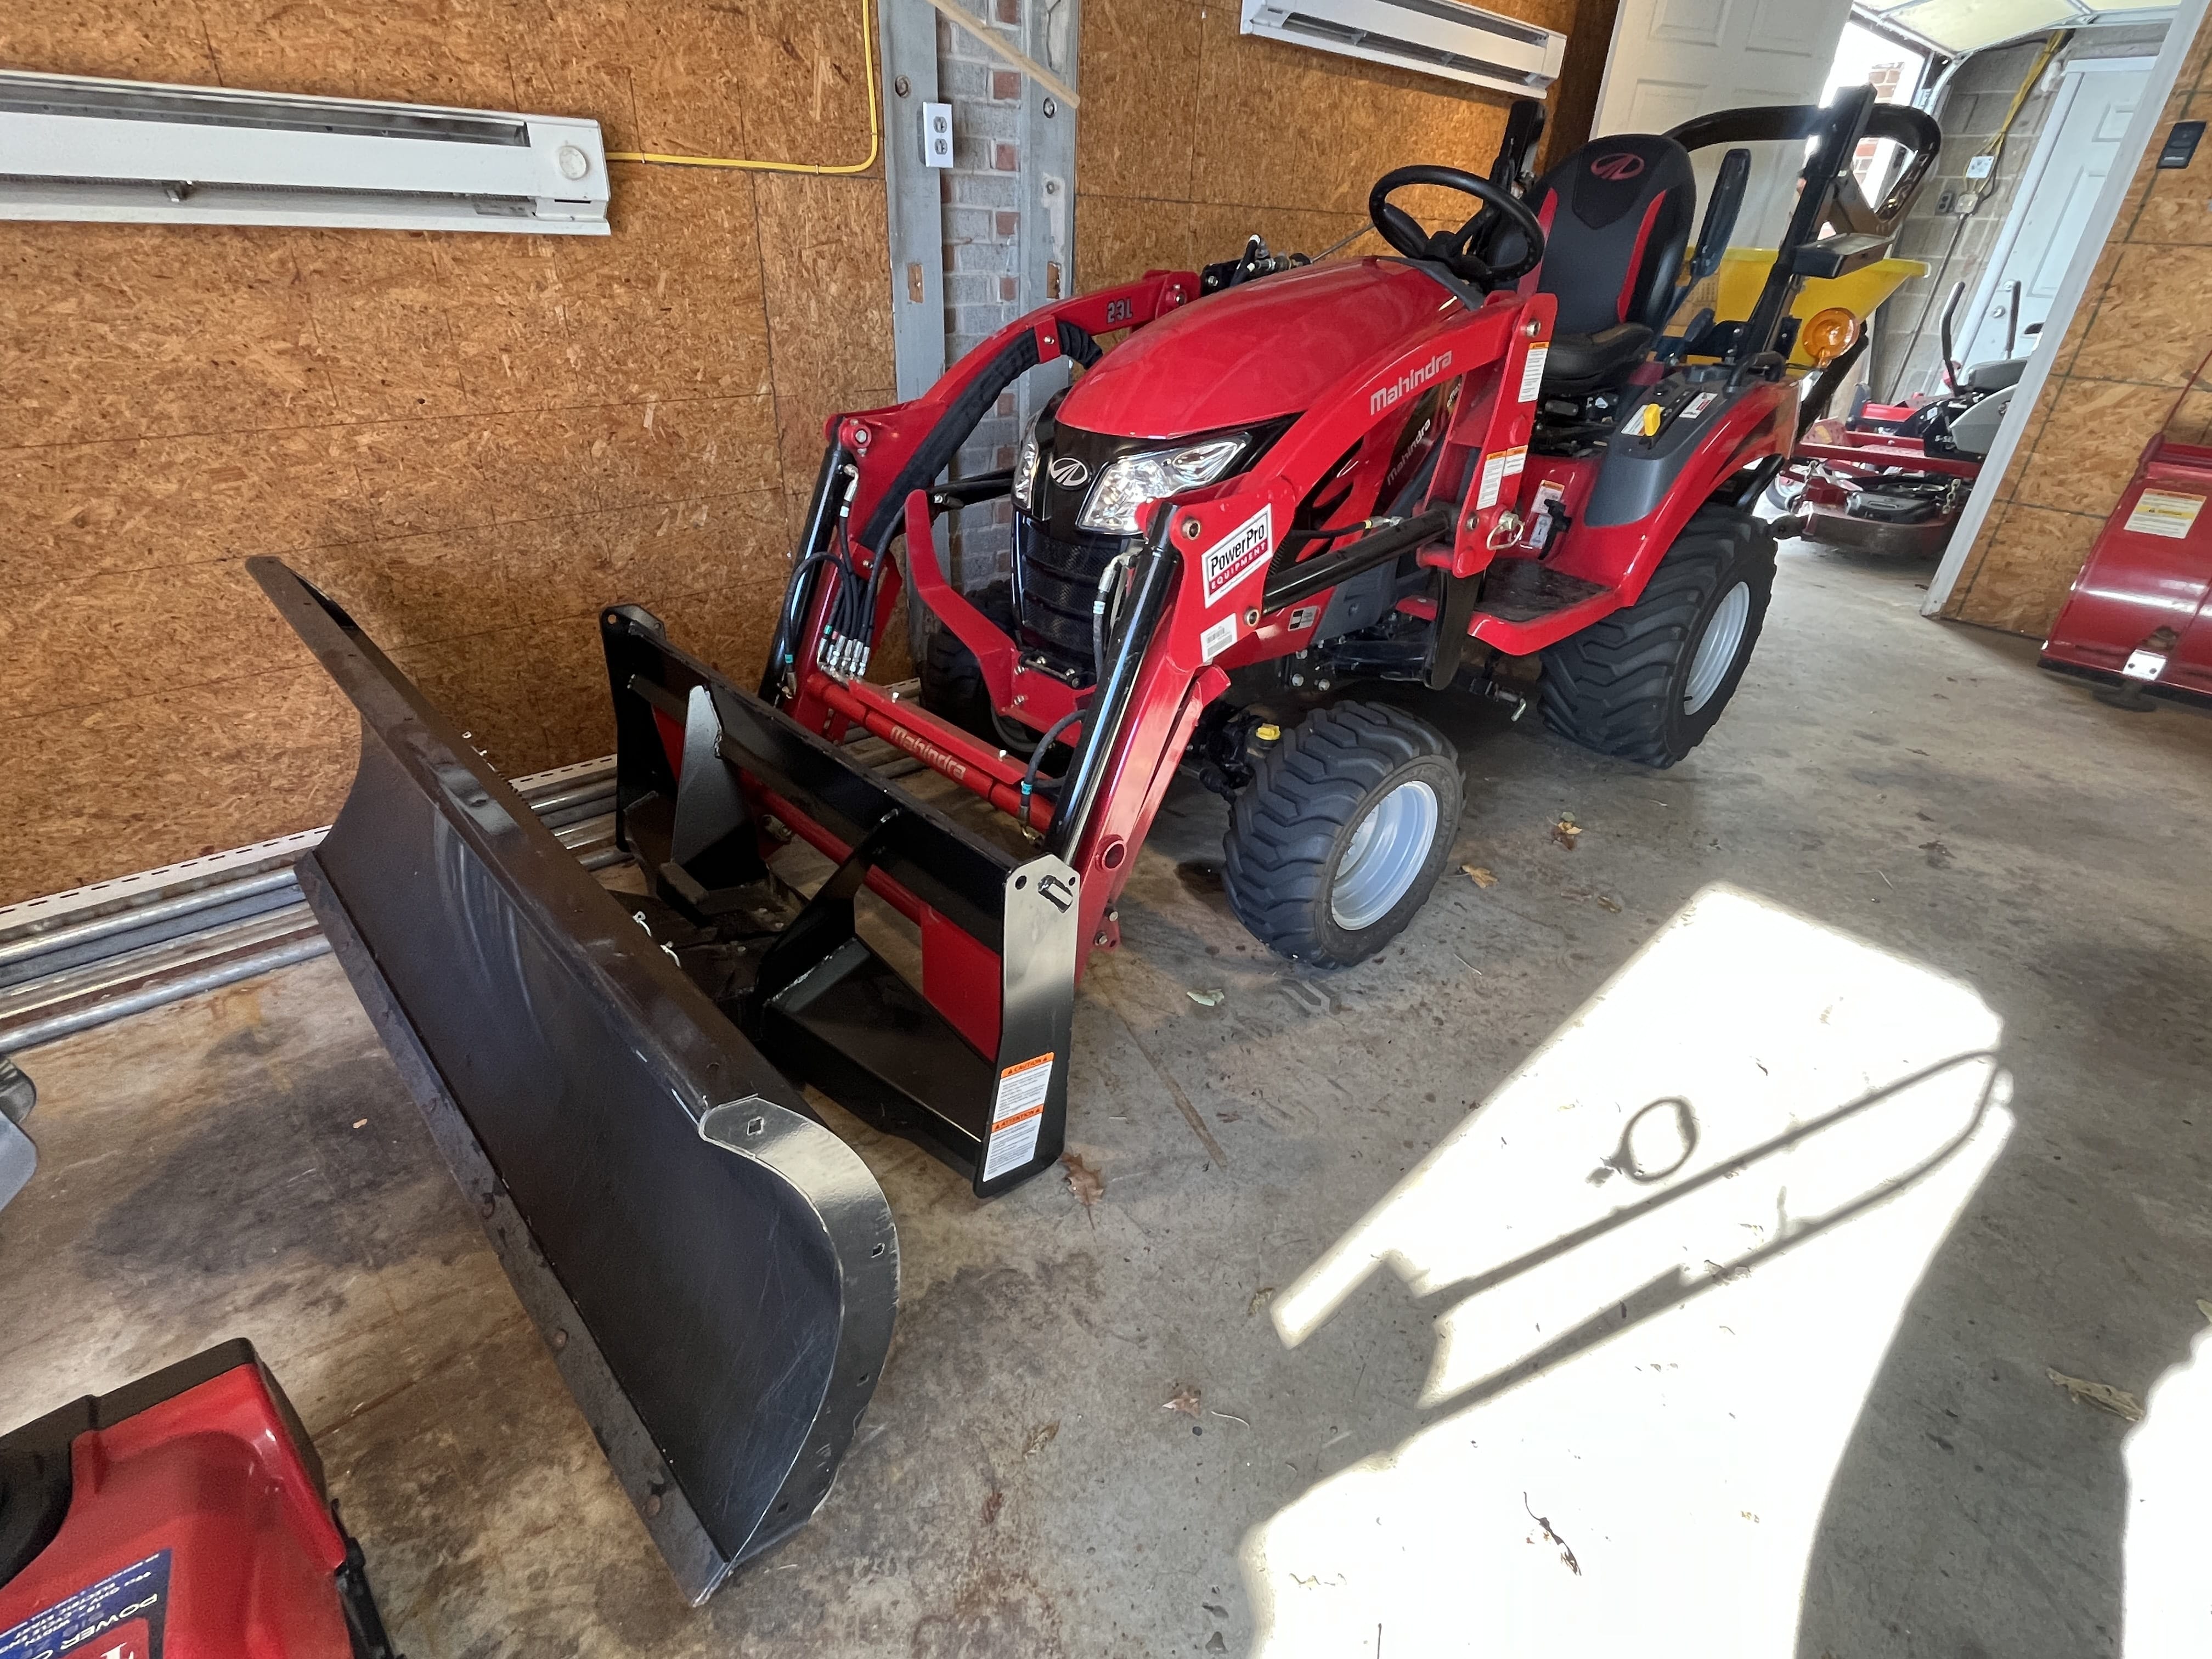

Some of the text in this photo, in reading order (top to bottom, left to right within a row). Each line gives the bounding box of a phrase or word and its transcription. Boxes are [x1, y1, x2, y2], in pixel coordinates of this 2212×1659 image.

[1107, 298, 1133, 324] 23L
[1370, 350, 1453, 416] Mahindra
[1210, 524, 1265, 577] PowerPro
[1211, 543, 1267, 590] EQUIPMENT
[890, 725, 967, 780] Mahindra
[1014, 1058, 1041, 1073] CAUTION
[60, 1593, 158, 1650] POWER
